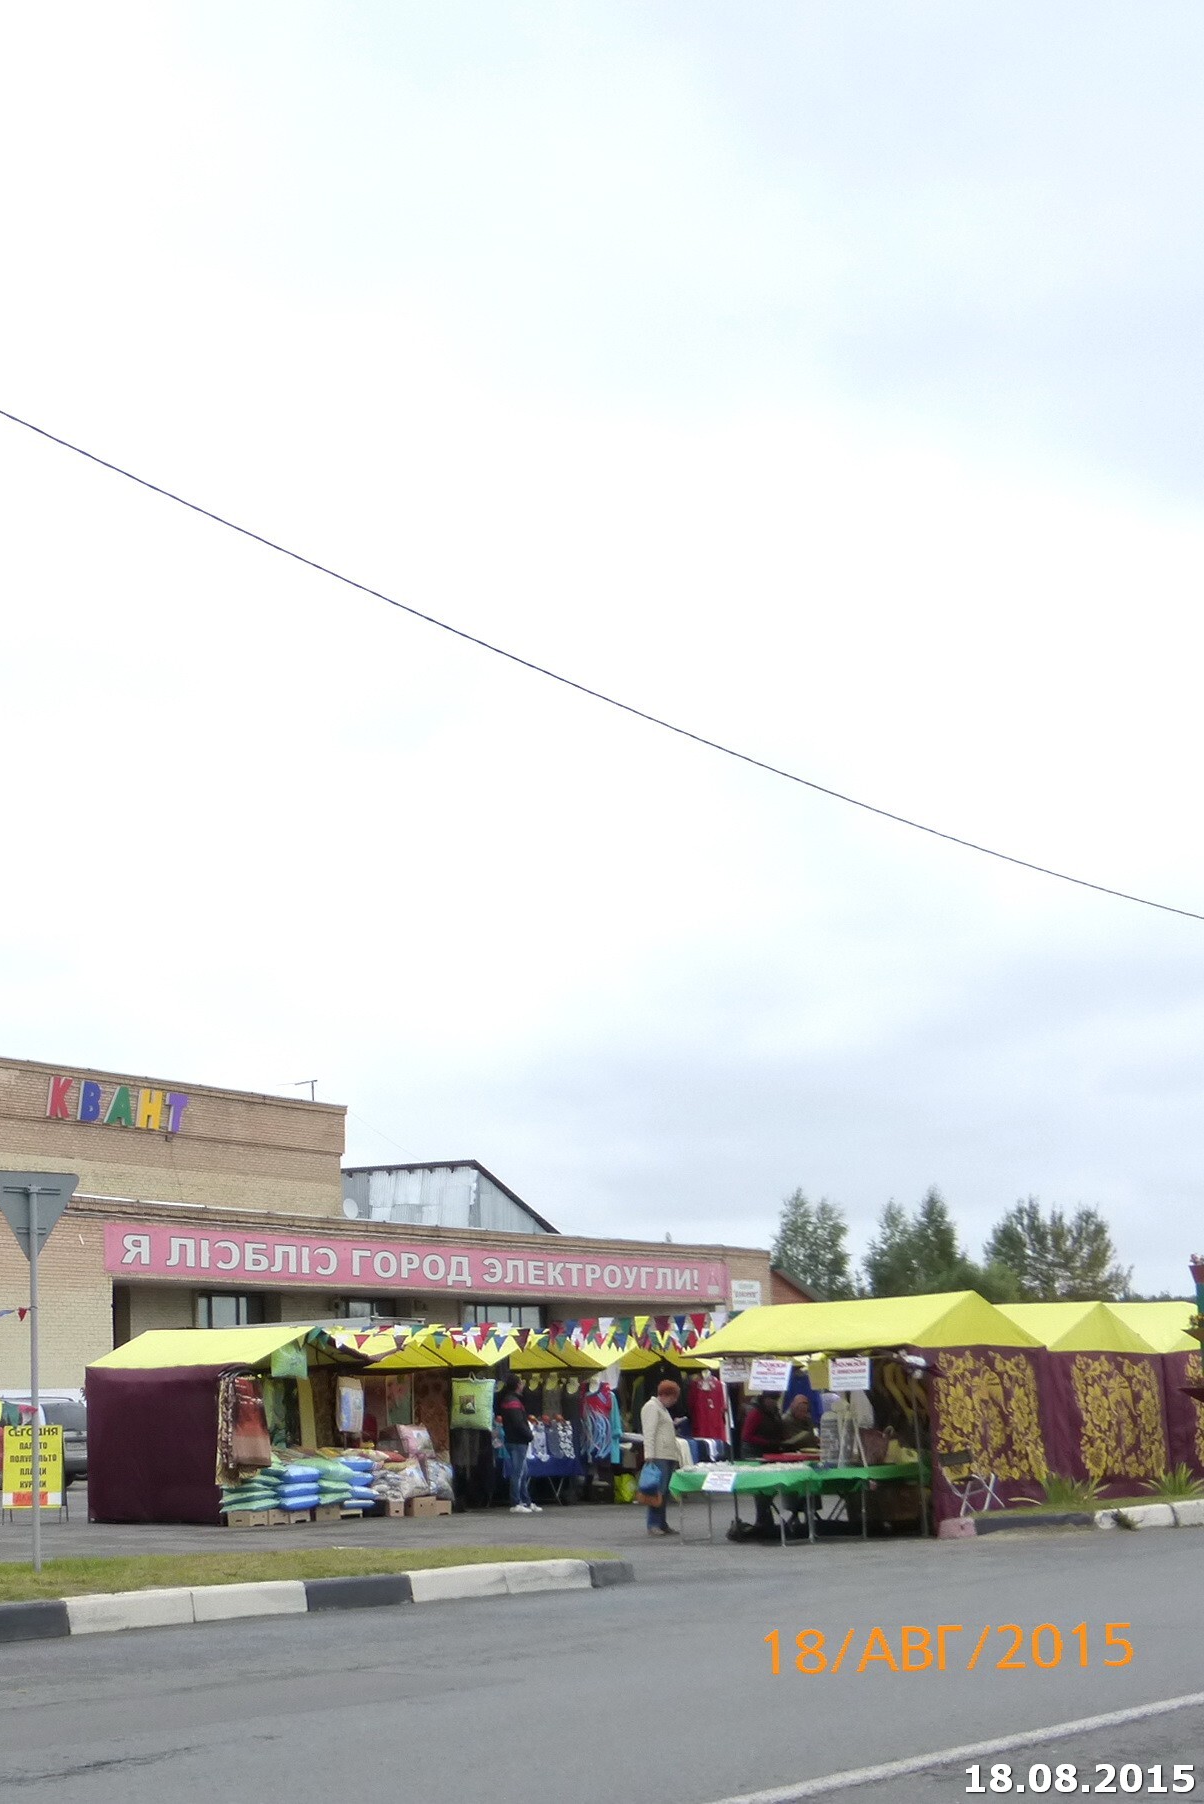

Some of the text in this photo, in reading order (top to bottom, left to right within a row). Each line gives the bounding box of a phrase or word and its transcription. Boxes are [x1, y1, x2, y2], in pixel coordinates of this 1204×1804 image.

[46, 1076, 189, 1134] КВАНТ
[121, 1233, 151, 1265] Я
[351, 1249, 473, 1288] ГОРОД
[482, 1257, 700, 1292] ЭЛЕКТРОУГЛИ!
